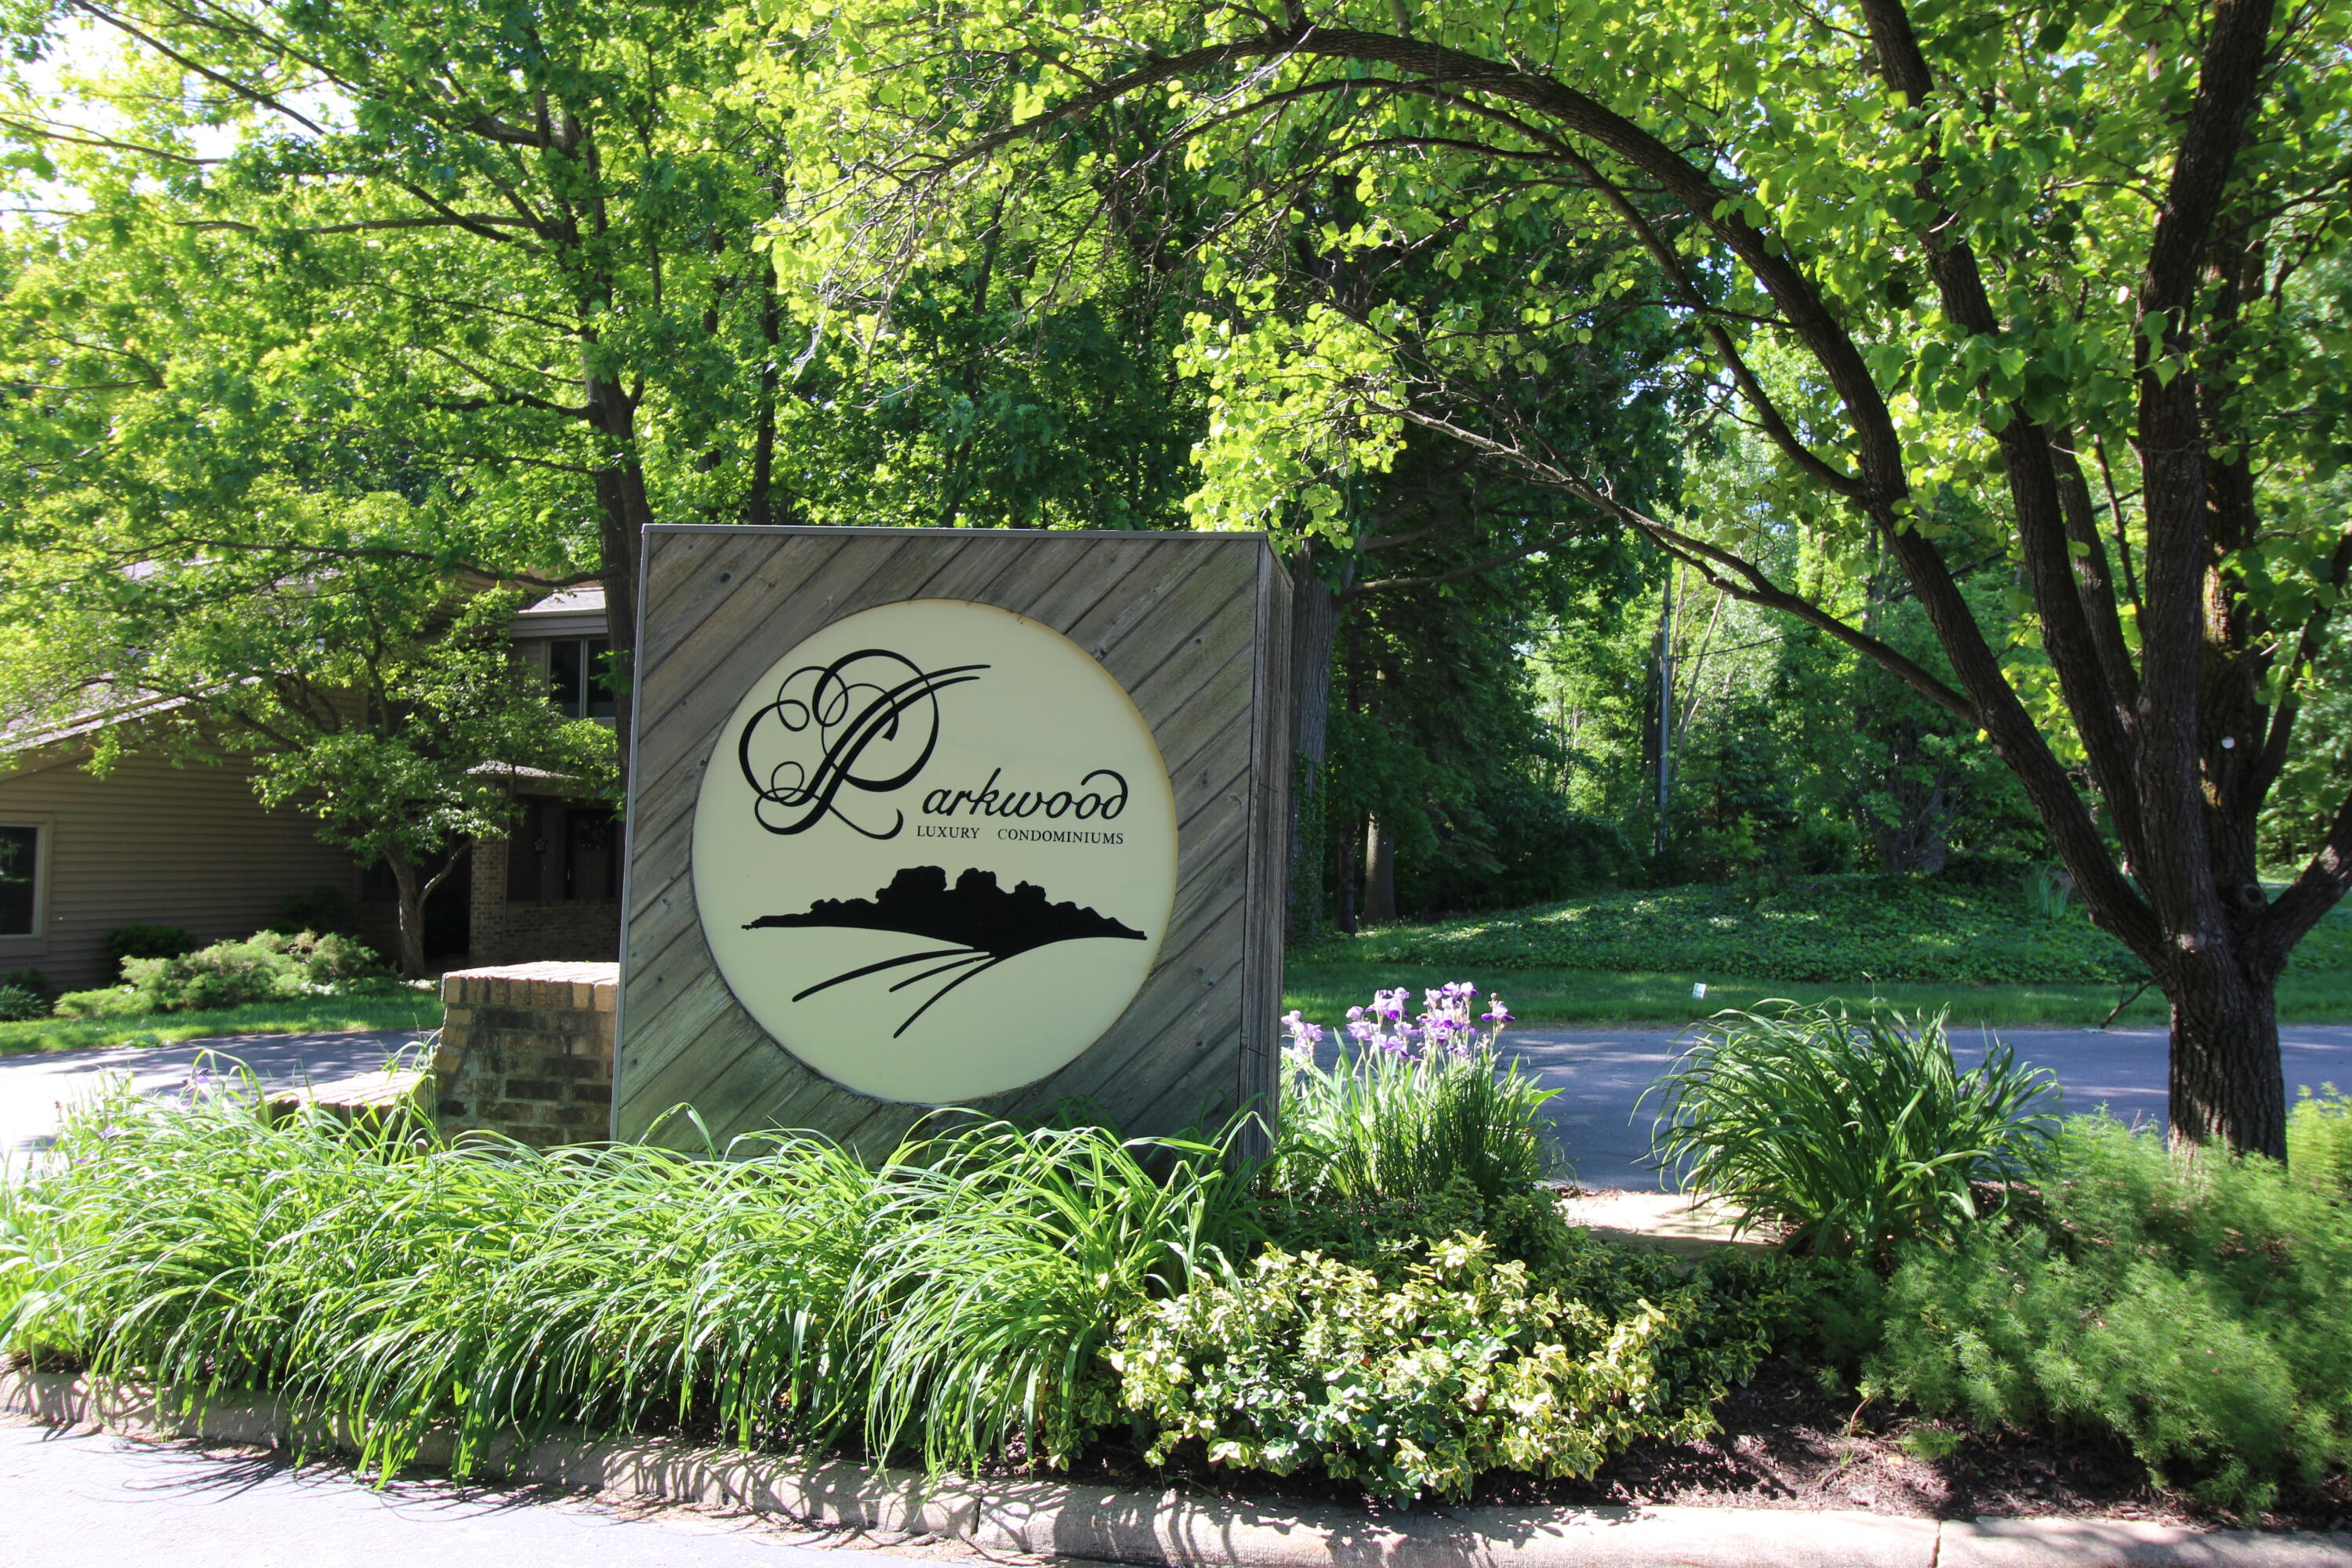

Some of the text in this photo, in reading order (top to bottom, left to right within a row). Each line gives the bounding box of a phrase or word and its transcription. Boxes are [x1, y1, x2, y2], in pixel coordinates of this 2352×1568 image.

[739, 649, 1128, 840] Parkwood
[916, 826, 1123, 844] LUXURY CONDOMINIUMS
